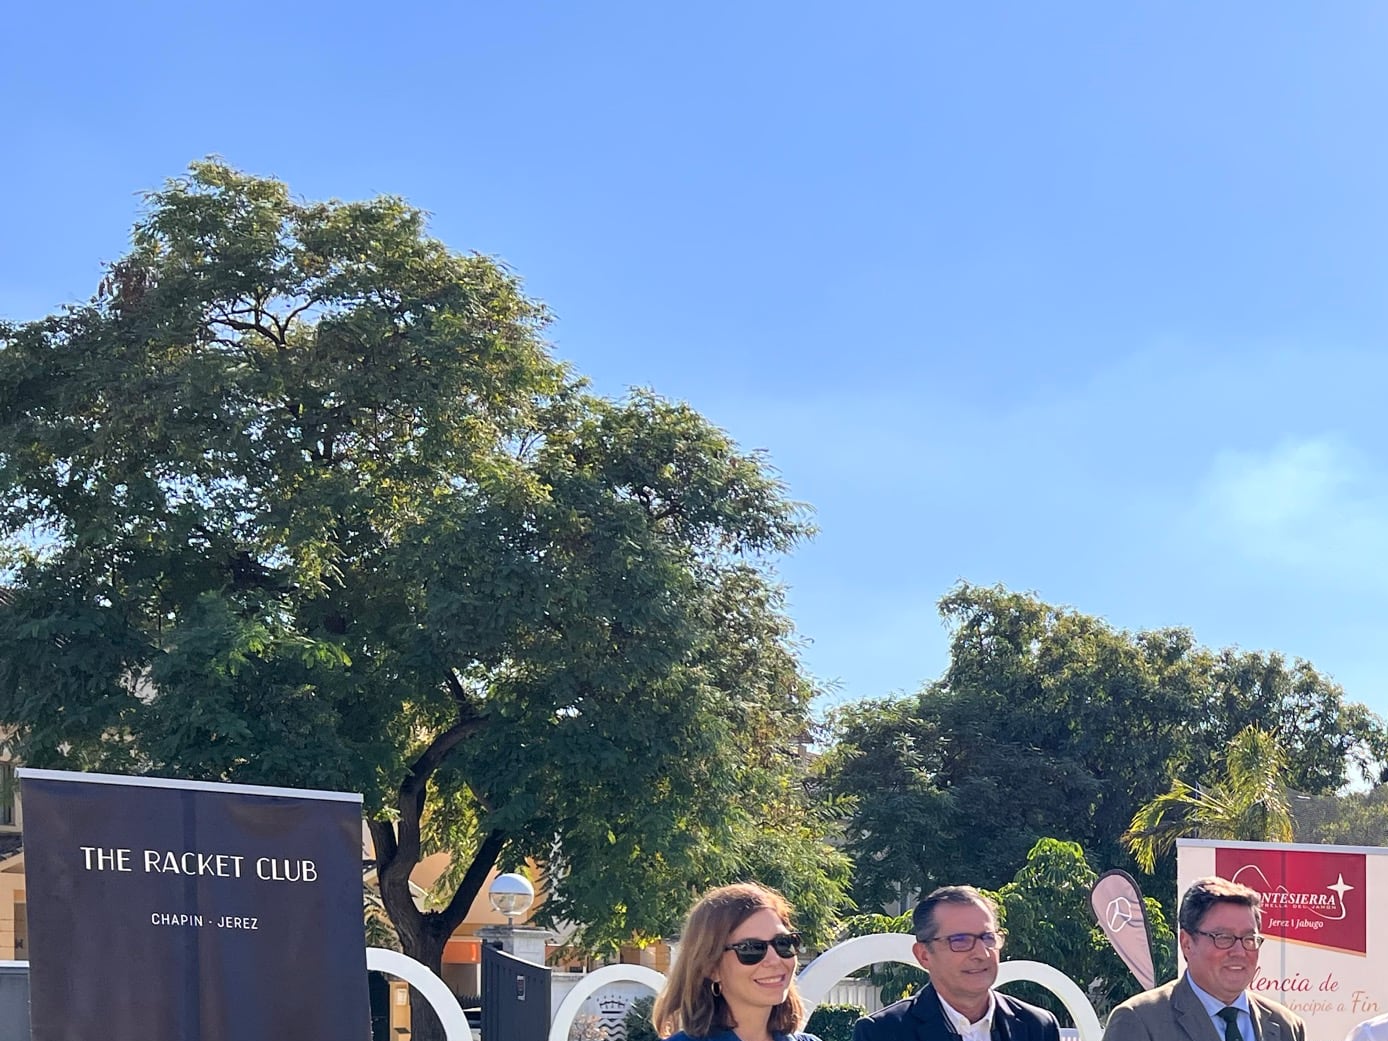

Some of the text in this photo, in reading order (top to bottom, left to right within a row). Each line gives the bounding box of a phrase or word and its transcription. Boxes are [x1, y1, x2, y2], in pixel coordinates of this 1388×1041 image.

[80, 846, 318, 882] THE RACKET CLUB
[1259, 892, 1336, 906] NTESIERRA
[151, 912, 203, 927] CHAPIN
[217, 916, 259, 930] JEREZ
[1268, 918, 1289, 929] Jerez
[1295, 919, 1324, 930] Jabugo
[1318, 972, 1340, 992] de
[1336, 1003, 1345, 1013] a
[1351, 990, 1380, 1014] Fin
